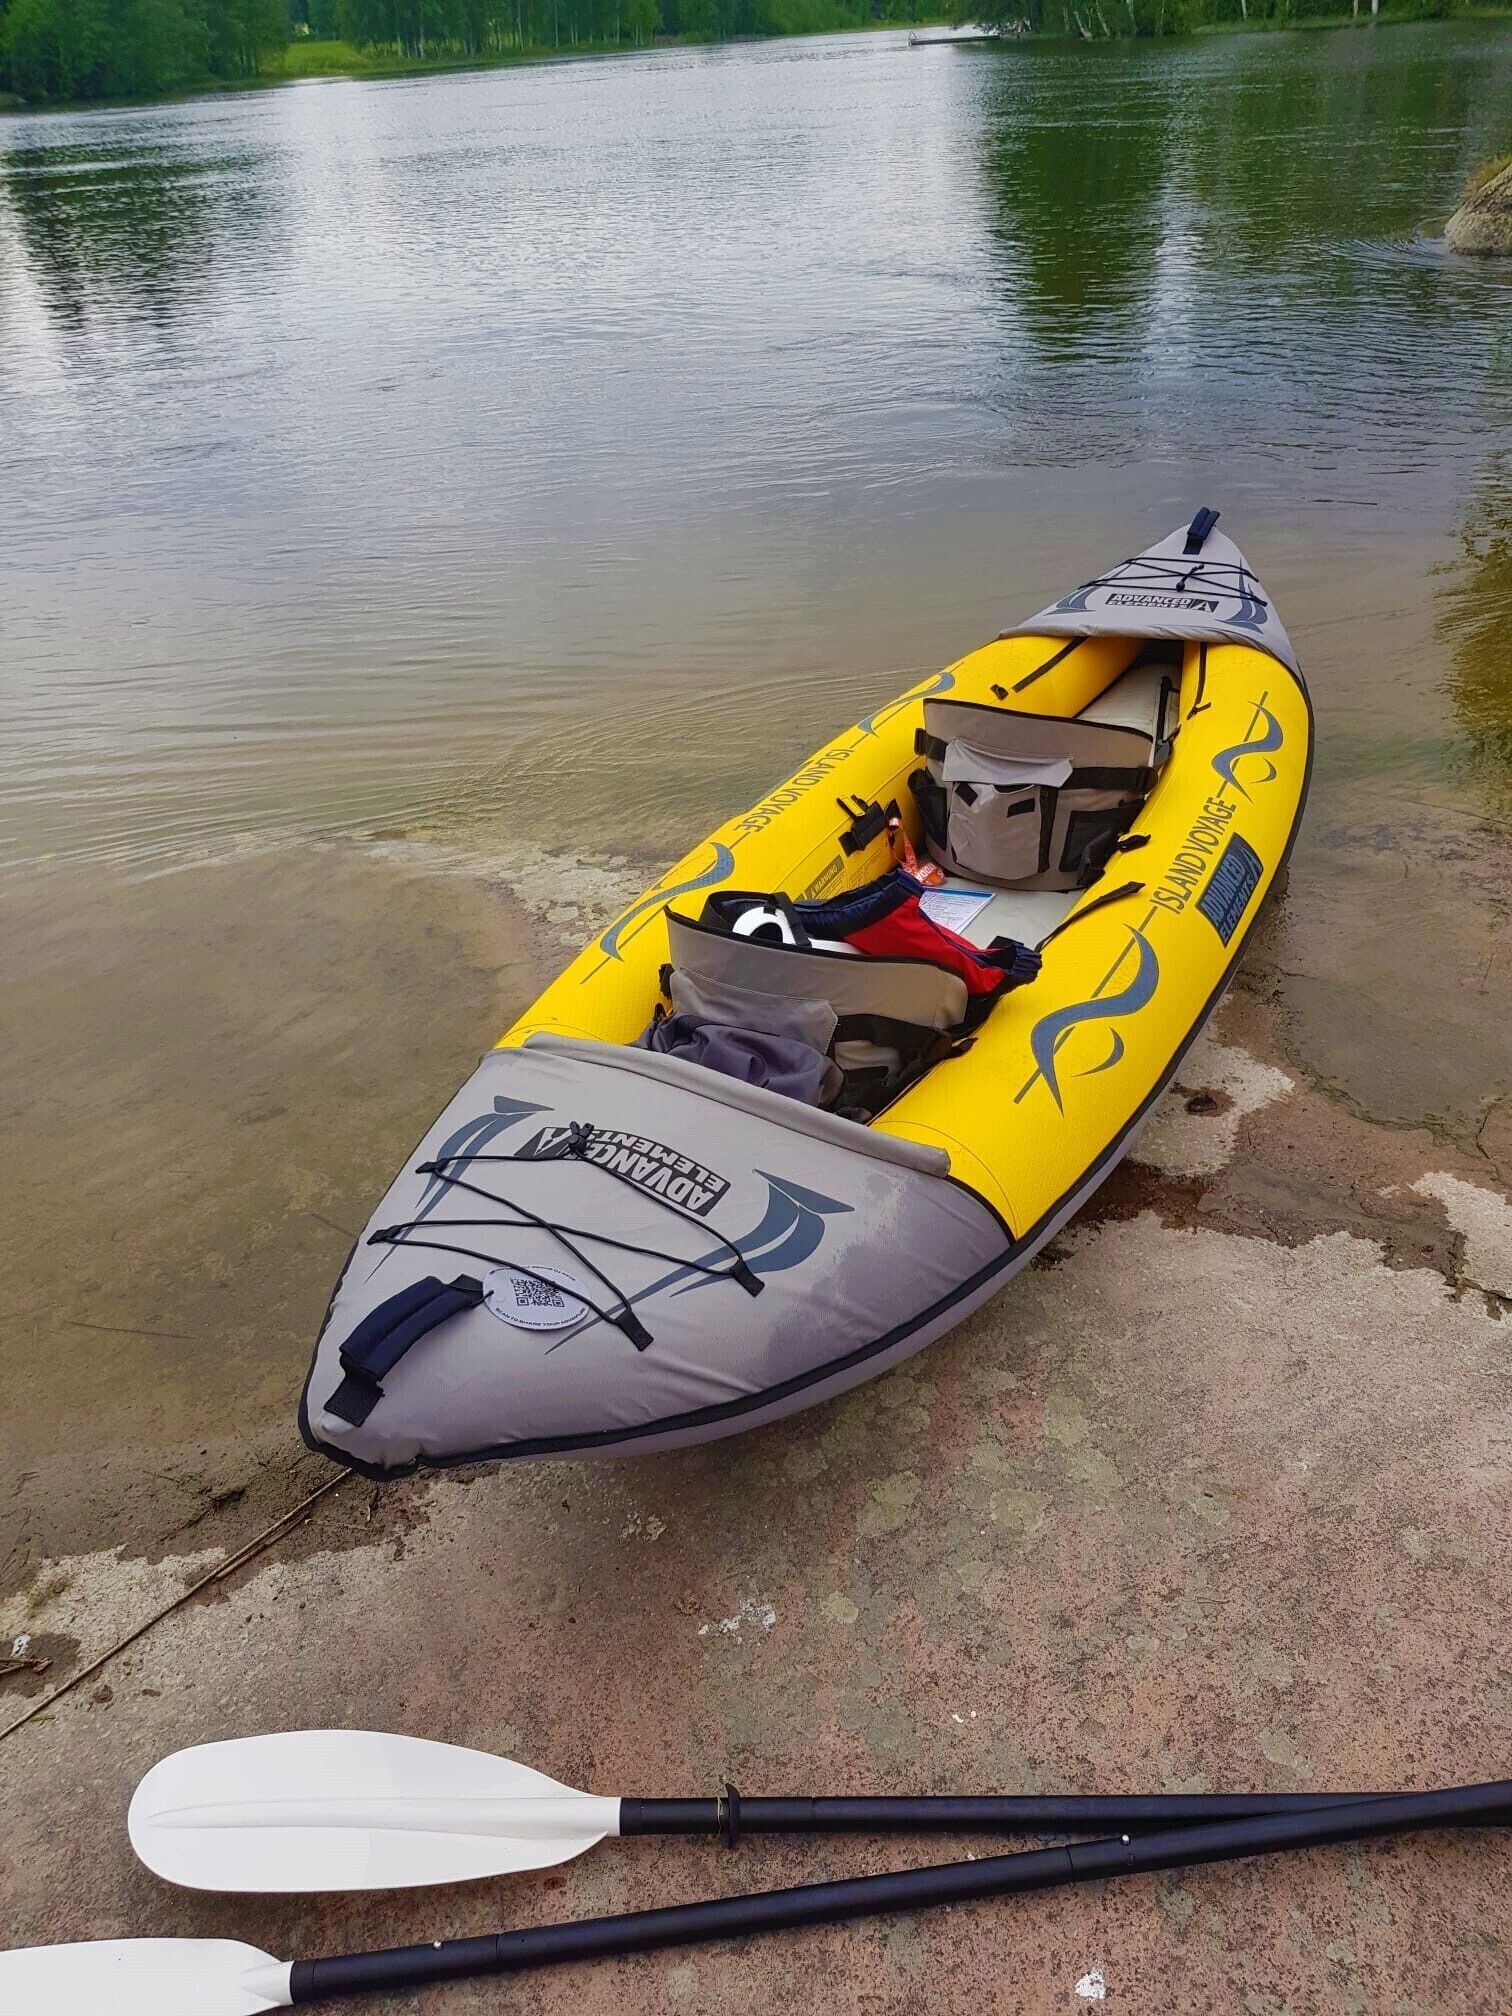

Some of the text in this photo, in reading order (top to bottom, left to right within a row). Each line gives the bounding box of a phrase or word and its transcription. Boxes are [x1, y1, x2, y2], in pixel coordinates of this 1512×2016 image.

[1111, 594, 1192, 605] ADVANCED
[732, 748, 855, 833] ISLAND VOYAGE
[1150, 797, 1238, 915] ISLAND VOYAGE
[1201, 851, 1247, 927] ADVANCED
